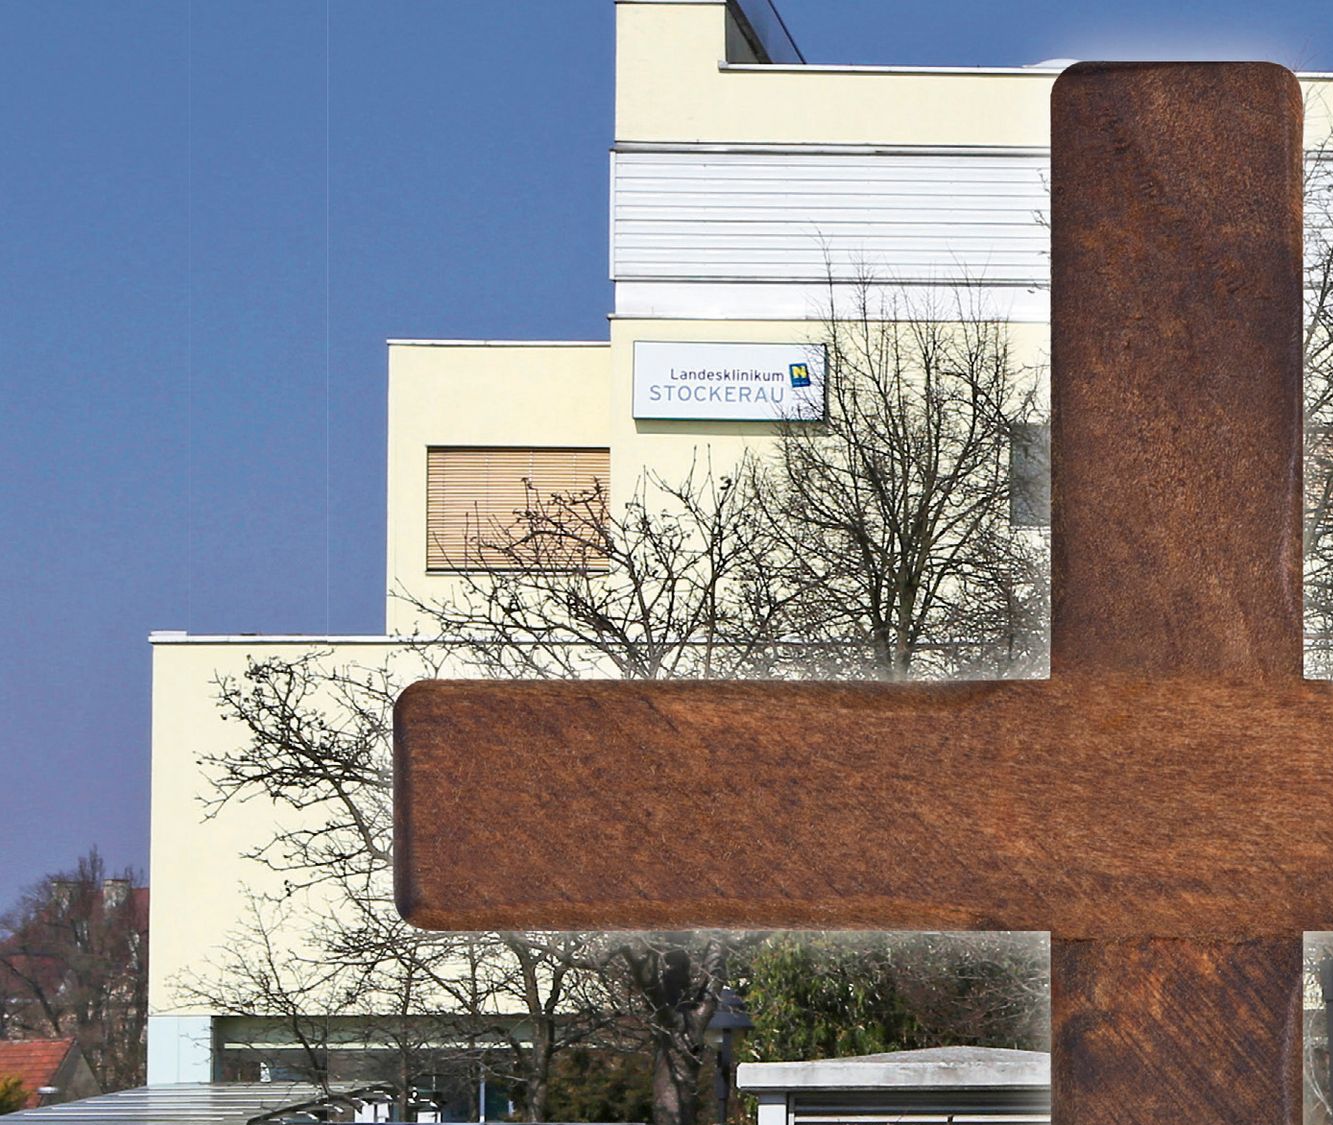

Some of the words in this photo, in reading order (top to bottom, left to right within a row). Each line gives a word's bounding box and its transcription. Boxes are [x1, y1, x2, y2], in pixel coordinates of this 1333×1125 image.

[670, 369, 784, 382] Landesklinikum
[791, 366, 807, 379] N
[649, 385, 784, 403] STOCKERAU
